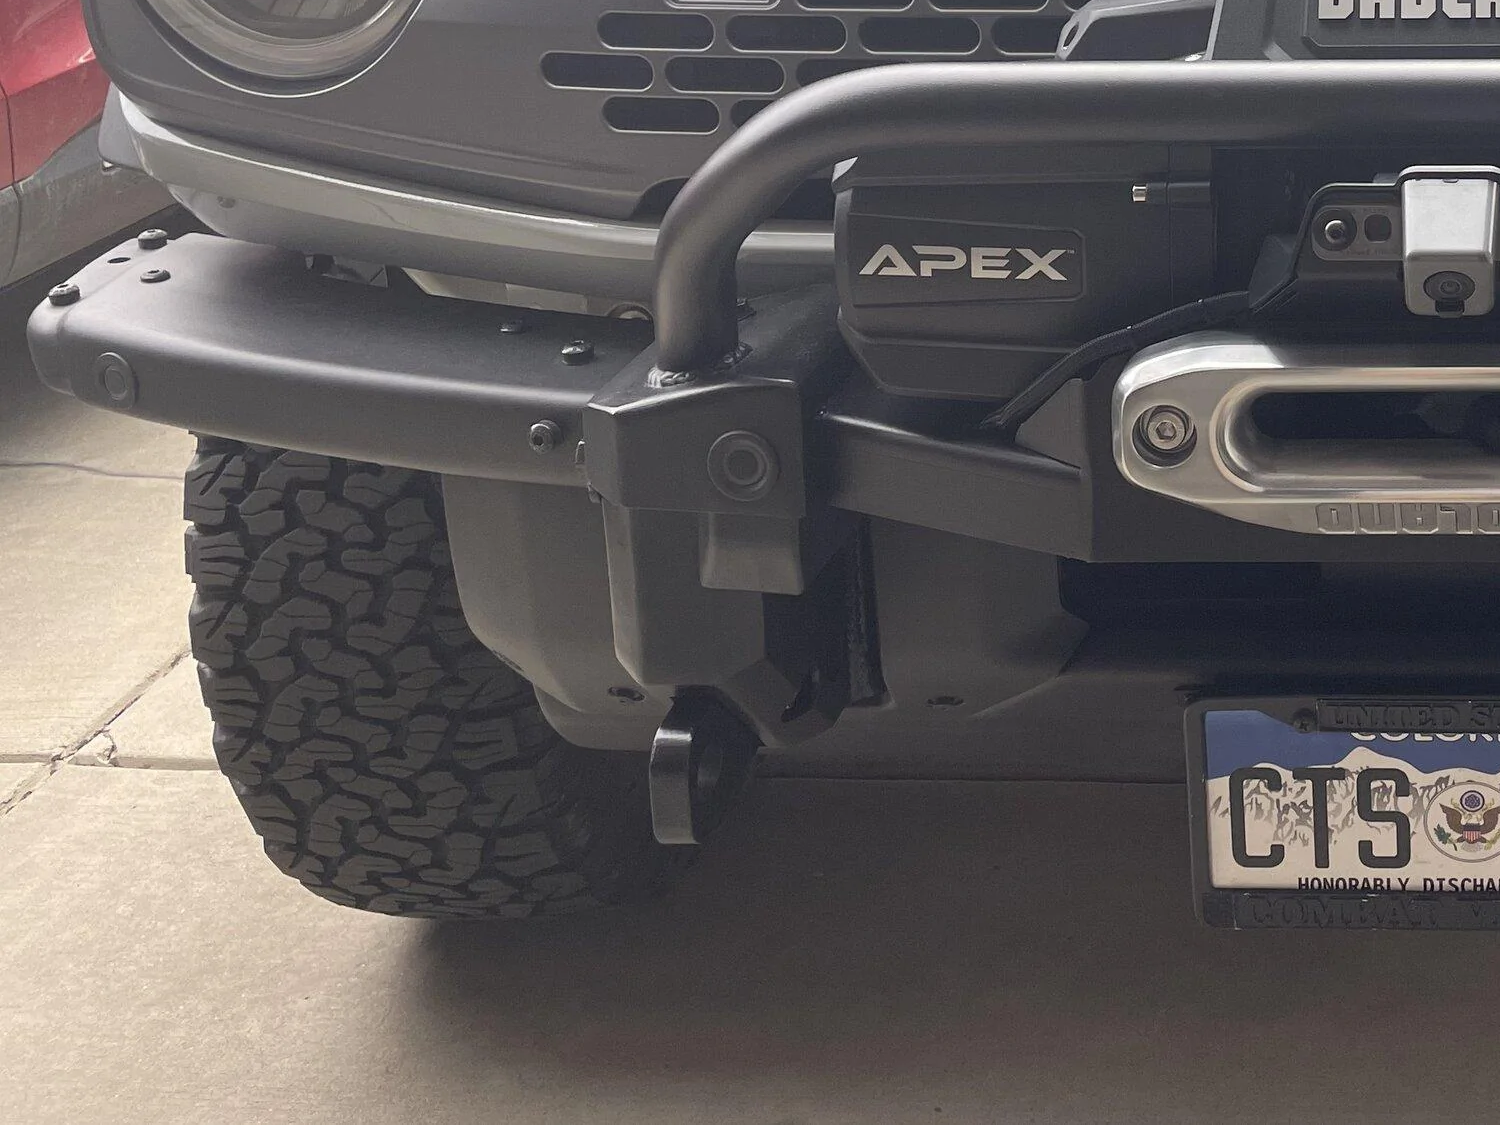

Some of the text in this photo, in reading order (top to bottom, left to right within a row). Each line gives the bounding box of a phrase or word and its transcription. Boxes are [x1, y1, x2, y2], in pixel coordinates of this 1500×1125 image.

[859, 243, 1068, 281] APEX
[1326, 702, 1459, 727] UNITED
[1228, 767, 1411, 870] CTS
[1297, 877, 1411, 892] HONORABLY
